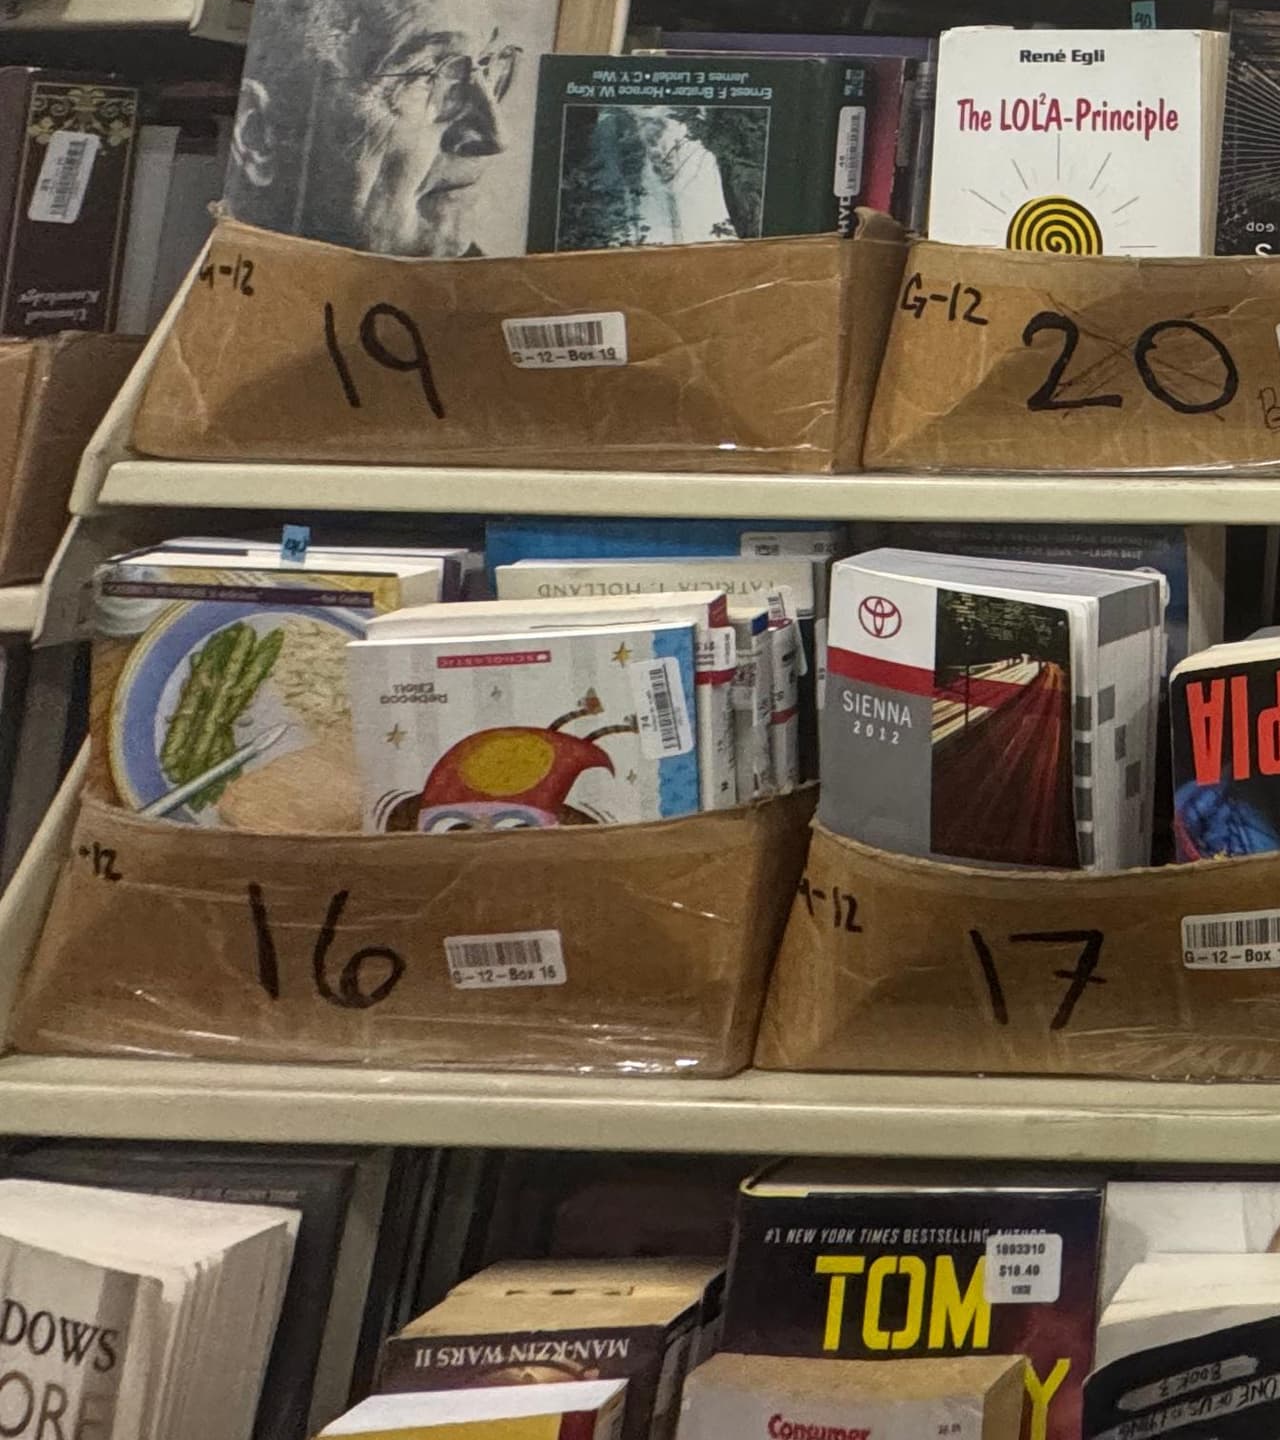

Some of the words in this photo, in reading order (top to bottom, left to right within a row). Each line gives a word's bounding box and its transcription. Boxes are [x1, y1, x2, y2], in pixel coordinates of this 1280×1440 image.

[1019, 48, 1066, 63] René
[1071, 48, 1105, 65] Egli
[709, 72, 749, 84] James
[566, 83, 596, 97] King
[731, 88, 772, 99] Ernest
[957, 98, 992, 131] The
[1245, 222, 1274, 233] GOD
[900, 272, 988, 326] G-12
[324, 301, 445, 420] 19
[599, 346, 617, 361] 19
[1021, 309, 1239, 415] 20
[537, 581, 641, 596] HOLLAND
[440, 654, 537, 668] SCHOLASTIC
[842, 689, 912, 728] SIENNA
[853, 720, 901, 744] 2012
[249, 882, 406, 1009] 16
[969, 928, 1107, 1031] 17
[764, 1229, 781, 1244] #1
[785, 1229, 816, 1245] NEW
[820, 1228, 856, 1245] YORK
[858, 1228, 900, 1244] TIMES
[903, 1227, 990, 1245] BESTSELLING
[815, 1254, 992, 1351] TOM
[414, 1346, 425, 1368] II
[437, 1345, 503, 1368] WARS
